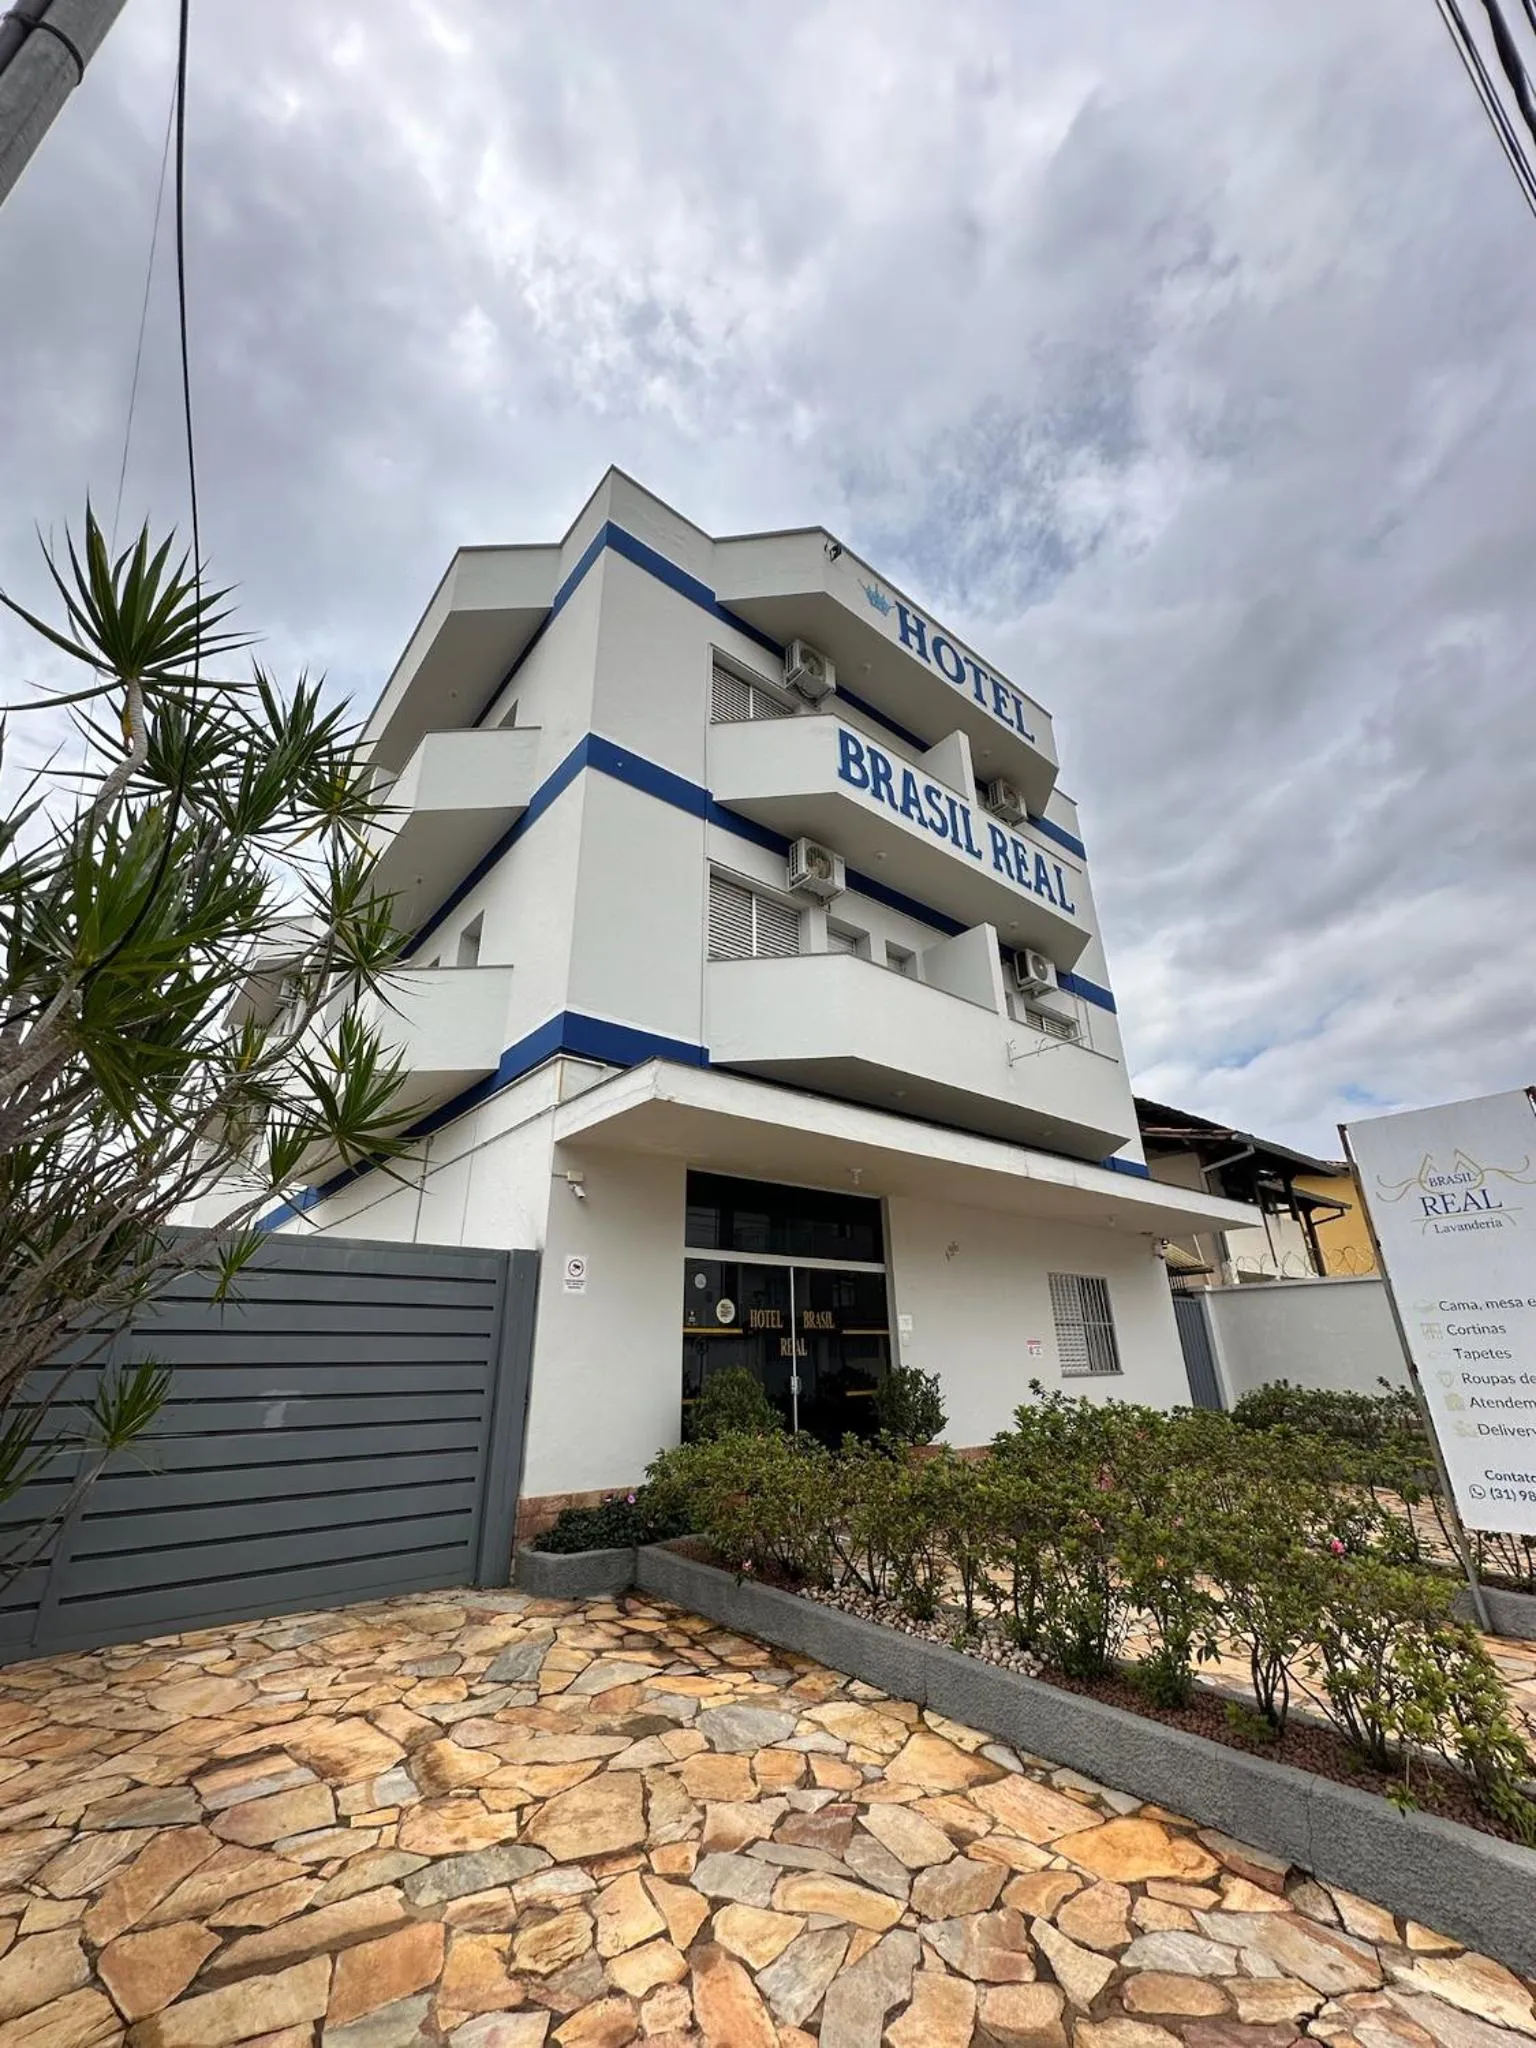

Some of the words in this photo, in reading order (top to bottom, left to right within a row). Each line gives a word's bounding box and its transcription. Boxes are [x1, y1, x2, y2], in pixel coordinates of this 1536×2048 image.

[895, 600, 1035, 743] HOTEL
[838, 728, 982, 861] BRASIL
[987, 821, 1075, 915] REAL
[1429, 1172, 1477, 1187] BRASIL
[1420, 1188, 1503, 1217] REAL
[1434, 1217, 1503, 1234] Lavanderia
[1439, 1300, 1482, 1311] Cama,
[1485, 1299, 1523, 1309] mesa
[750, 1309, 784, 1329] HOTEL
[802, 1310, 835, 1329] BRASIL
[1446, 1323, 1506, 1335] Cortinas
[1452, 1348, 1512, 1360] Tapetes
[1461, 1372, 1516, 1386] Roupas
[1490, 1487, 1517, 1502] (31)
